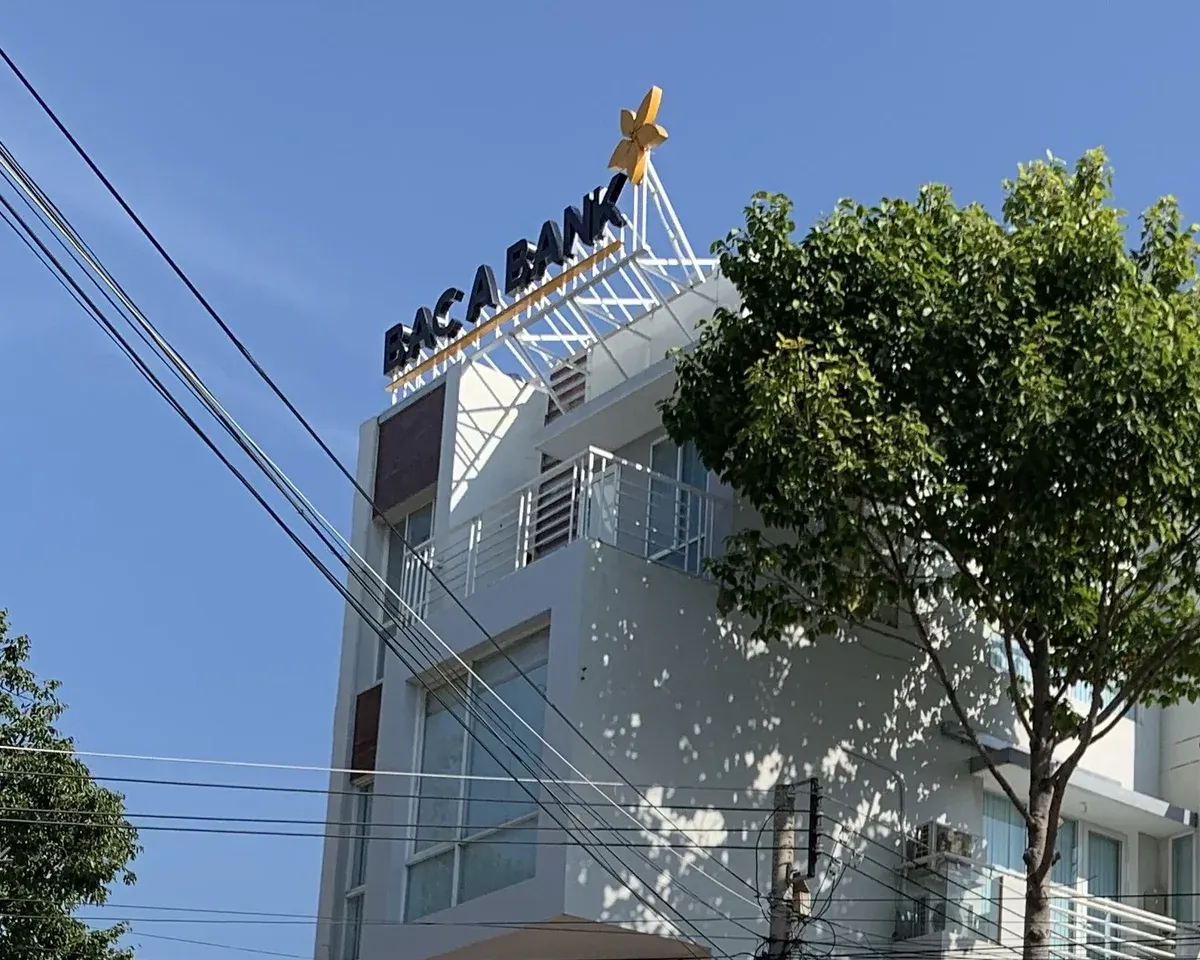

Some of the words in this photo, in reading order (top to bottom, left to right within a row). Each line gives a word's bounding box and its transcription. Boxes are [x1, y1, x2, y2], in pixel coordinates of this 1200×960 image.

[384, 288, 464, 376] BAC
[466, 264, 500, 323] A
[505, 172, 627, 297] BANK
